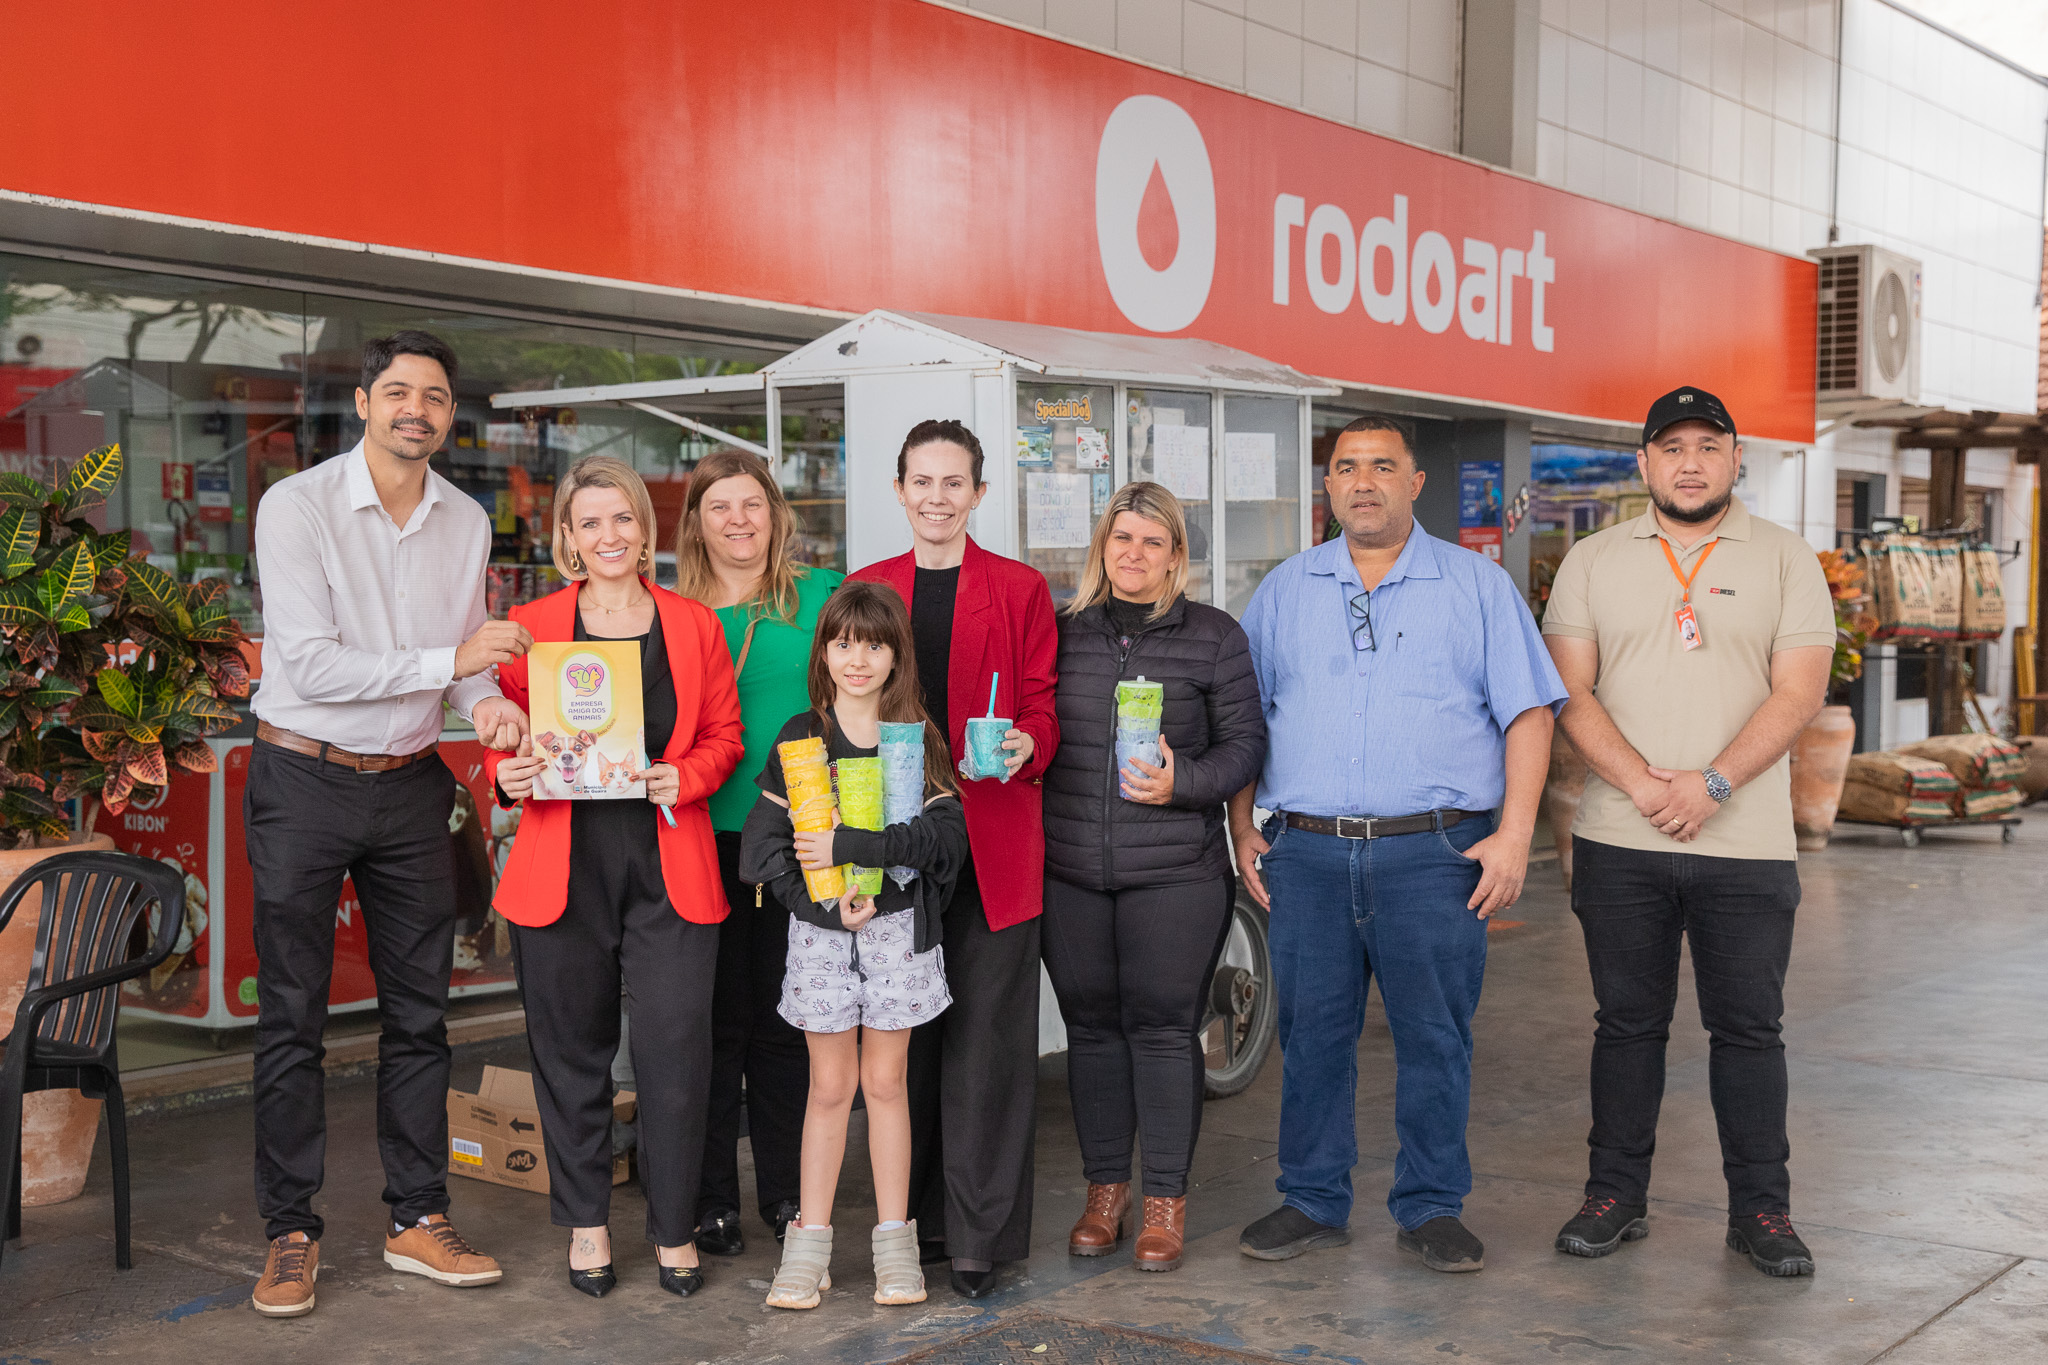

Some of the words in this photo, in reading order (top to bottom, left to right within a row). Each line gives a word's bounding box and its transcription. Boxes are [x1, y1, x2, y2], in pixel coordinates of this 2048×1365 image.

[1273, 193, 1556, 353] rodoart
[1036, 400, 1071, 421] Special
[1072, 396, 1091, 421] Dog
[508, 1153, 534, 1169] TANG
